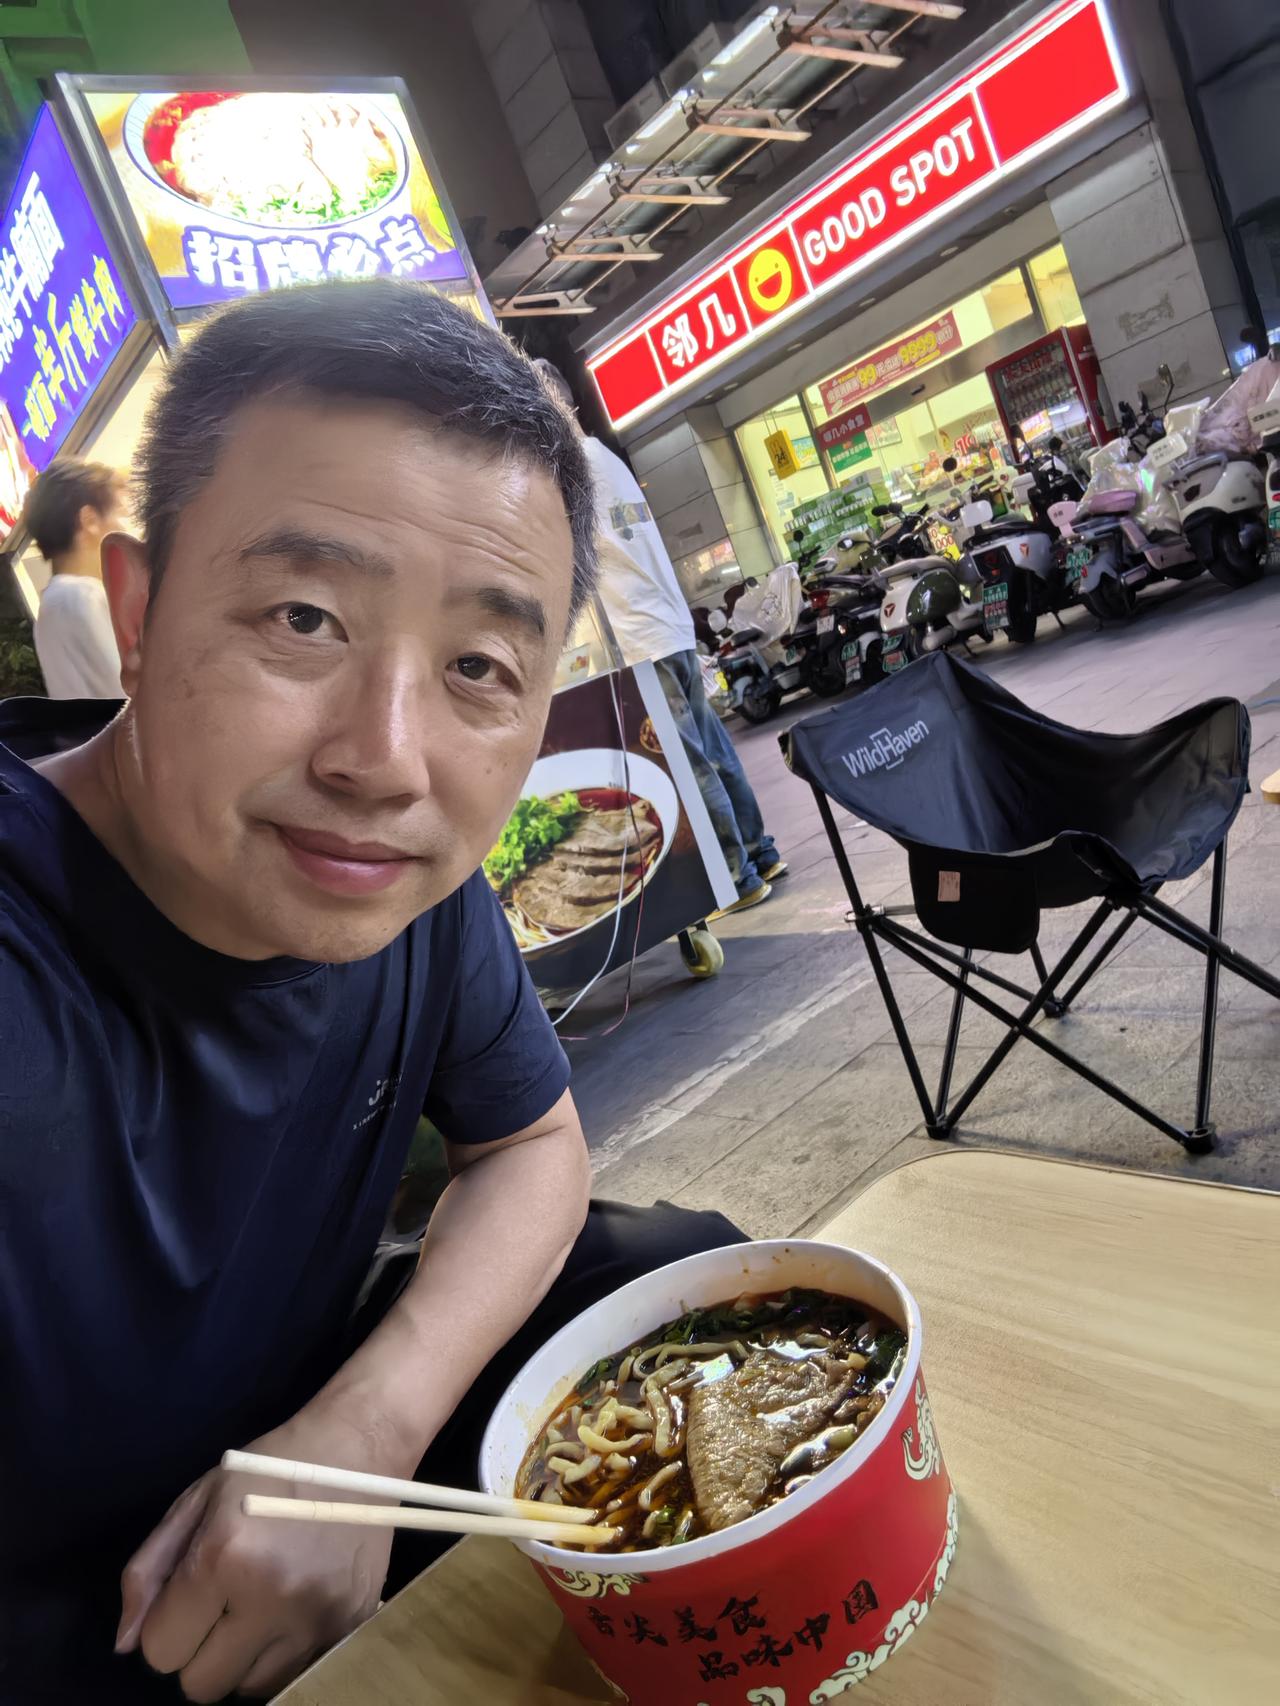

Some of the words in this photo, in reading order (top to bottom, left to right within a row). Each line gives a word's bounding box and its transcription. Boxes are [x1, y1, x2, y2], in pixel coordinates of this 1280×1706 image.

[802, 186, 887, 267] GOOD
[889, 116, 974, 208] SPOT
[187, 217, 437, 291] 招牌必点
[661, 292, 737, 369] 邻几
[841, 719, 931, 779] WildHaven
[697, 1579, 880, 1682] 品味中国
